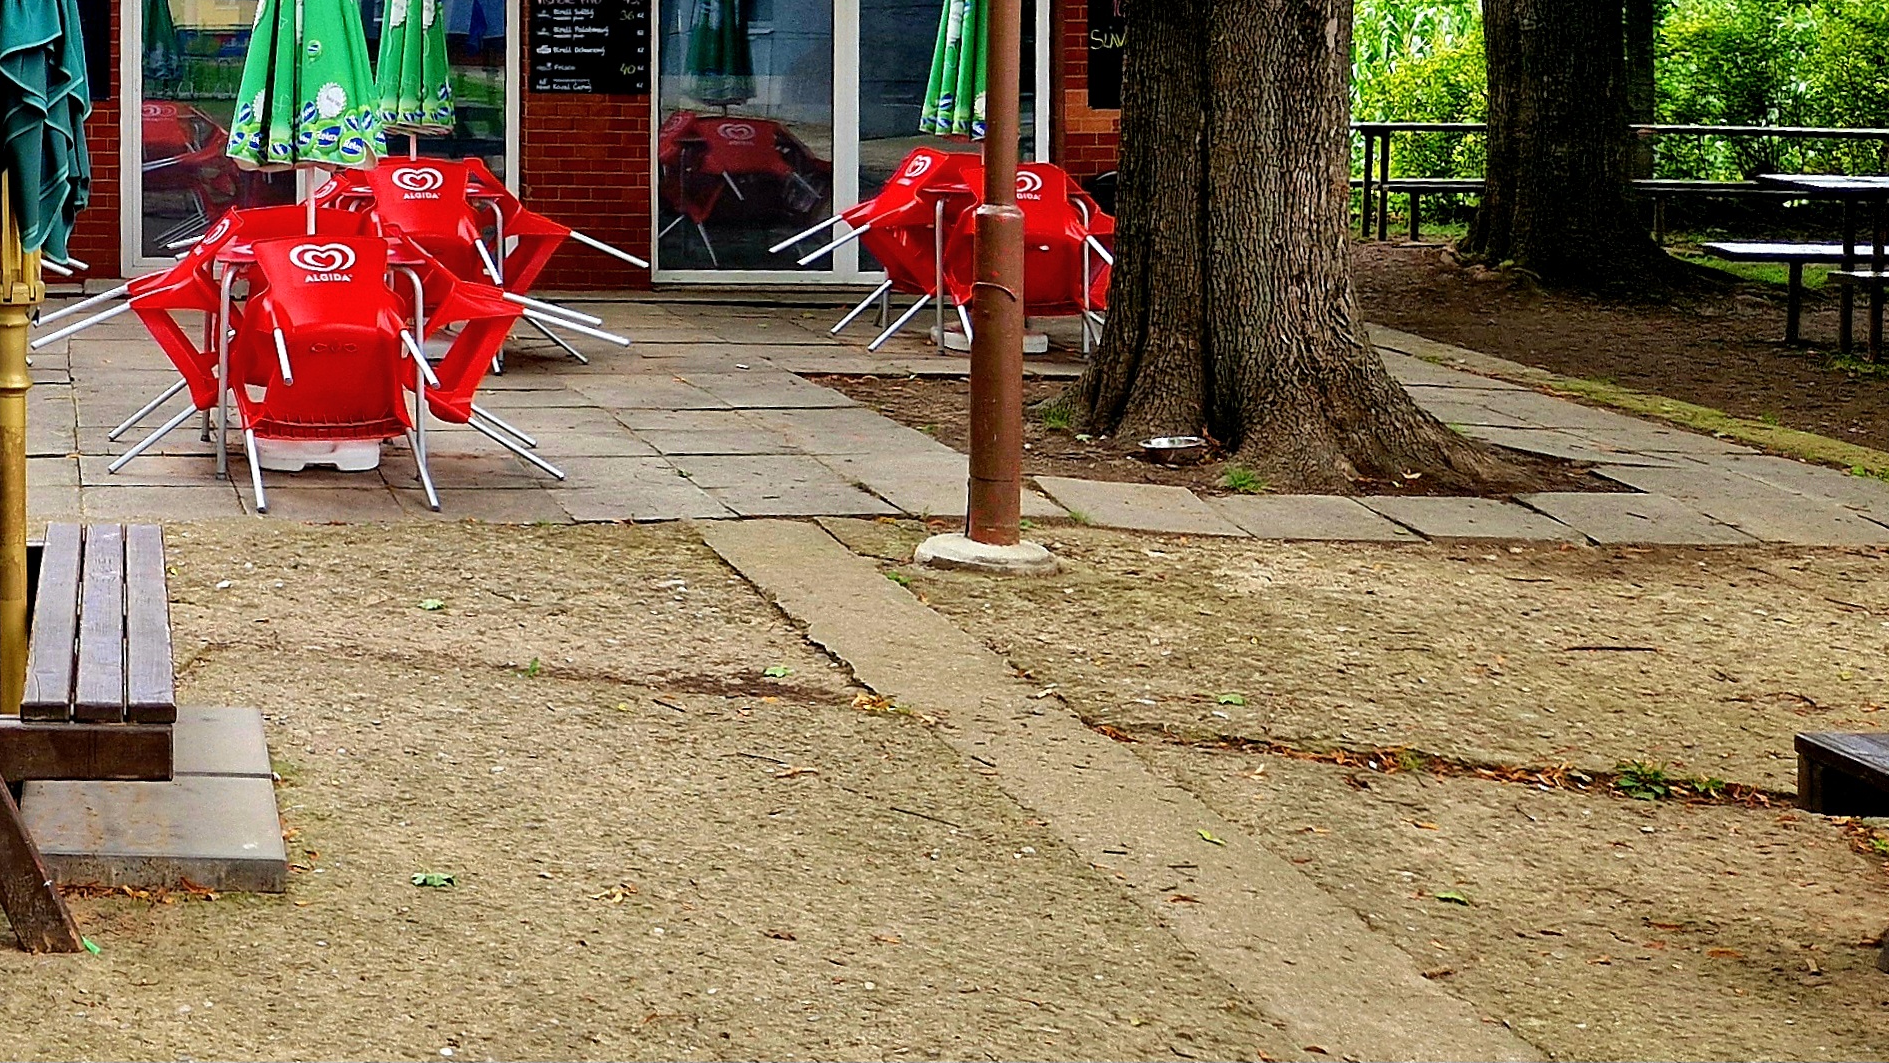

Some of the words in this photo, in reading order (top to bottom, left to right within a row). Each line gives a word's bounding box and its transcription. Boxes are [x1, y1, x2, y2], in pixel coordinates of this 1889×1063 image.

[620, 10, 634, 20] 36
[619, 63, 636, 75] 40
[403, 192, 439, 200] ALGIDA
[1016, 192, 1041, 200] GIDA
[304, 273, 351, 283] ALGIDA
